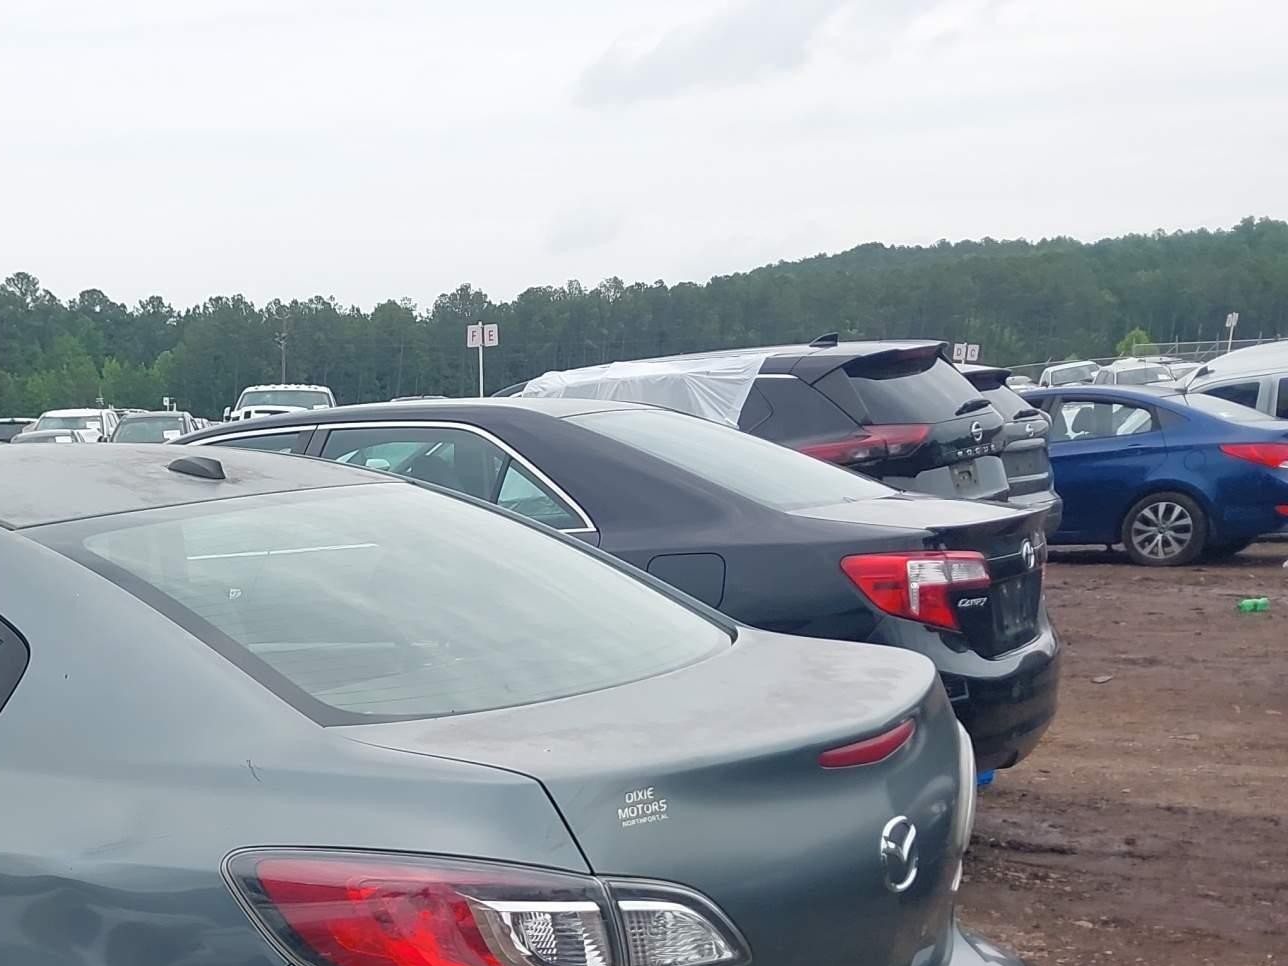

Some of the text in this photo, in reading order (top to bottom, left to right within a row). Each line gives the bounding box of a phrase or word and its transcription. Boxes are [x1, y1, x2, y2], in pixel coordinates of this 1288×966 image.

[471, 330, 477, 342] F
[488, 330, 494, 342] E
[625, 787, 655, 804] DIXIE
[617, 799, 667, 820] MOTORS
